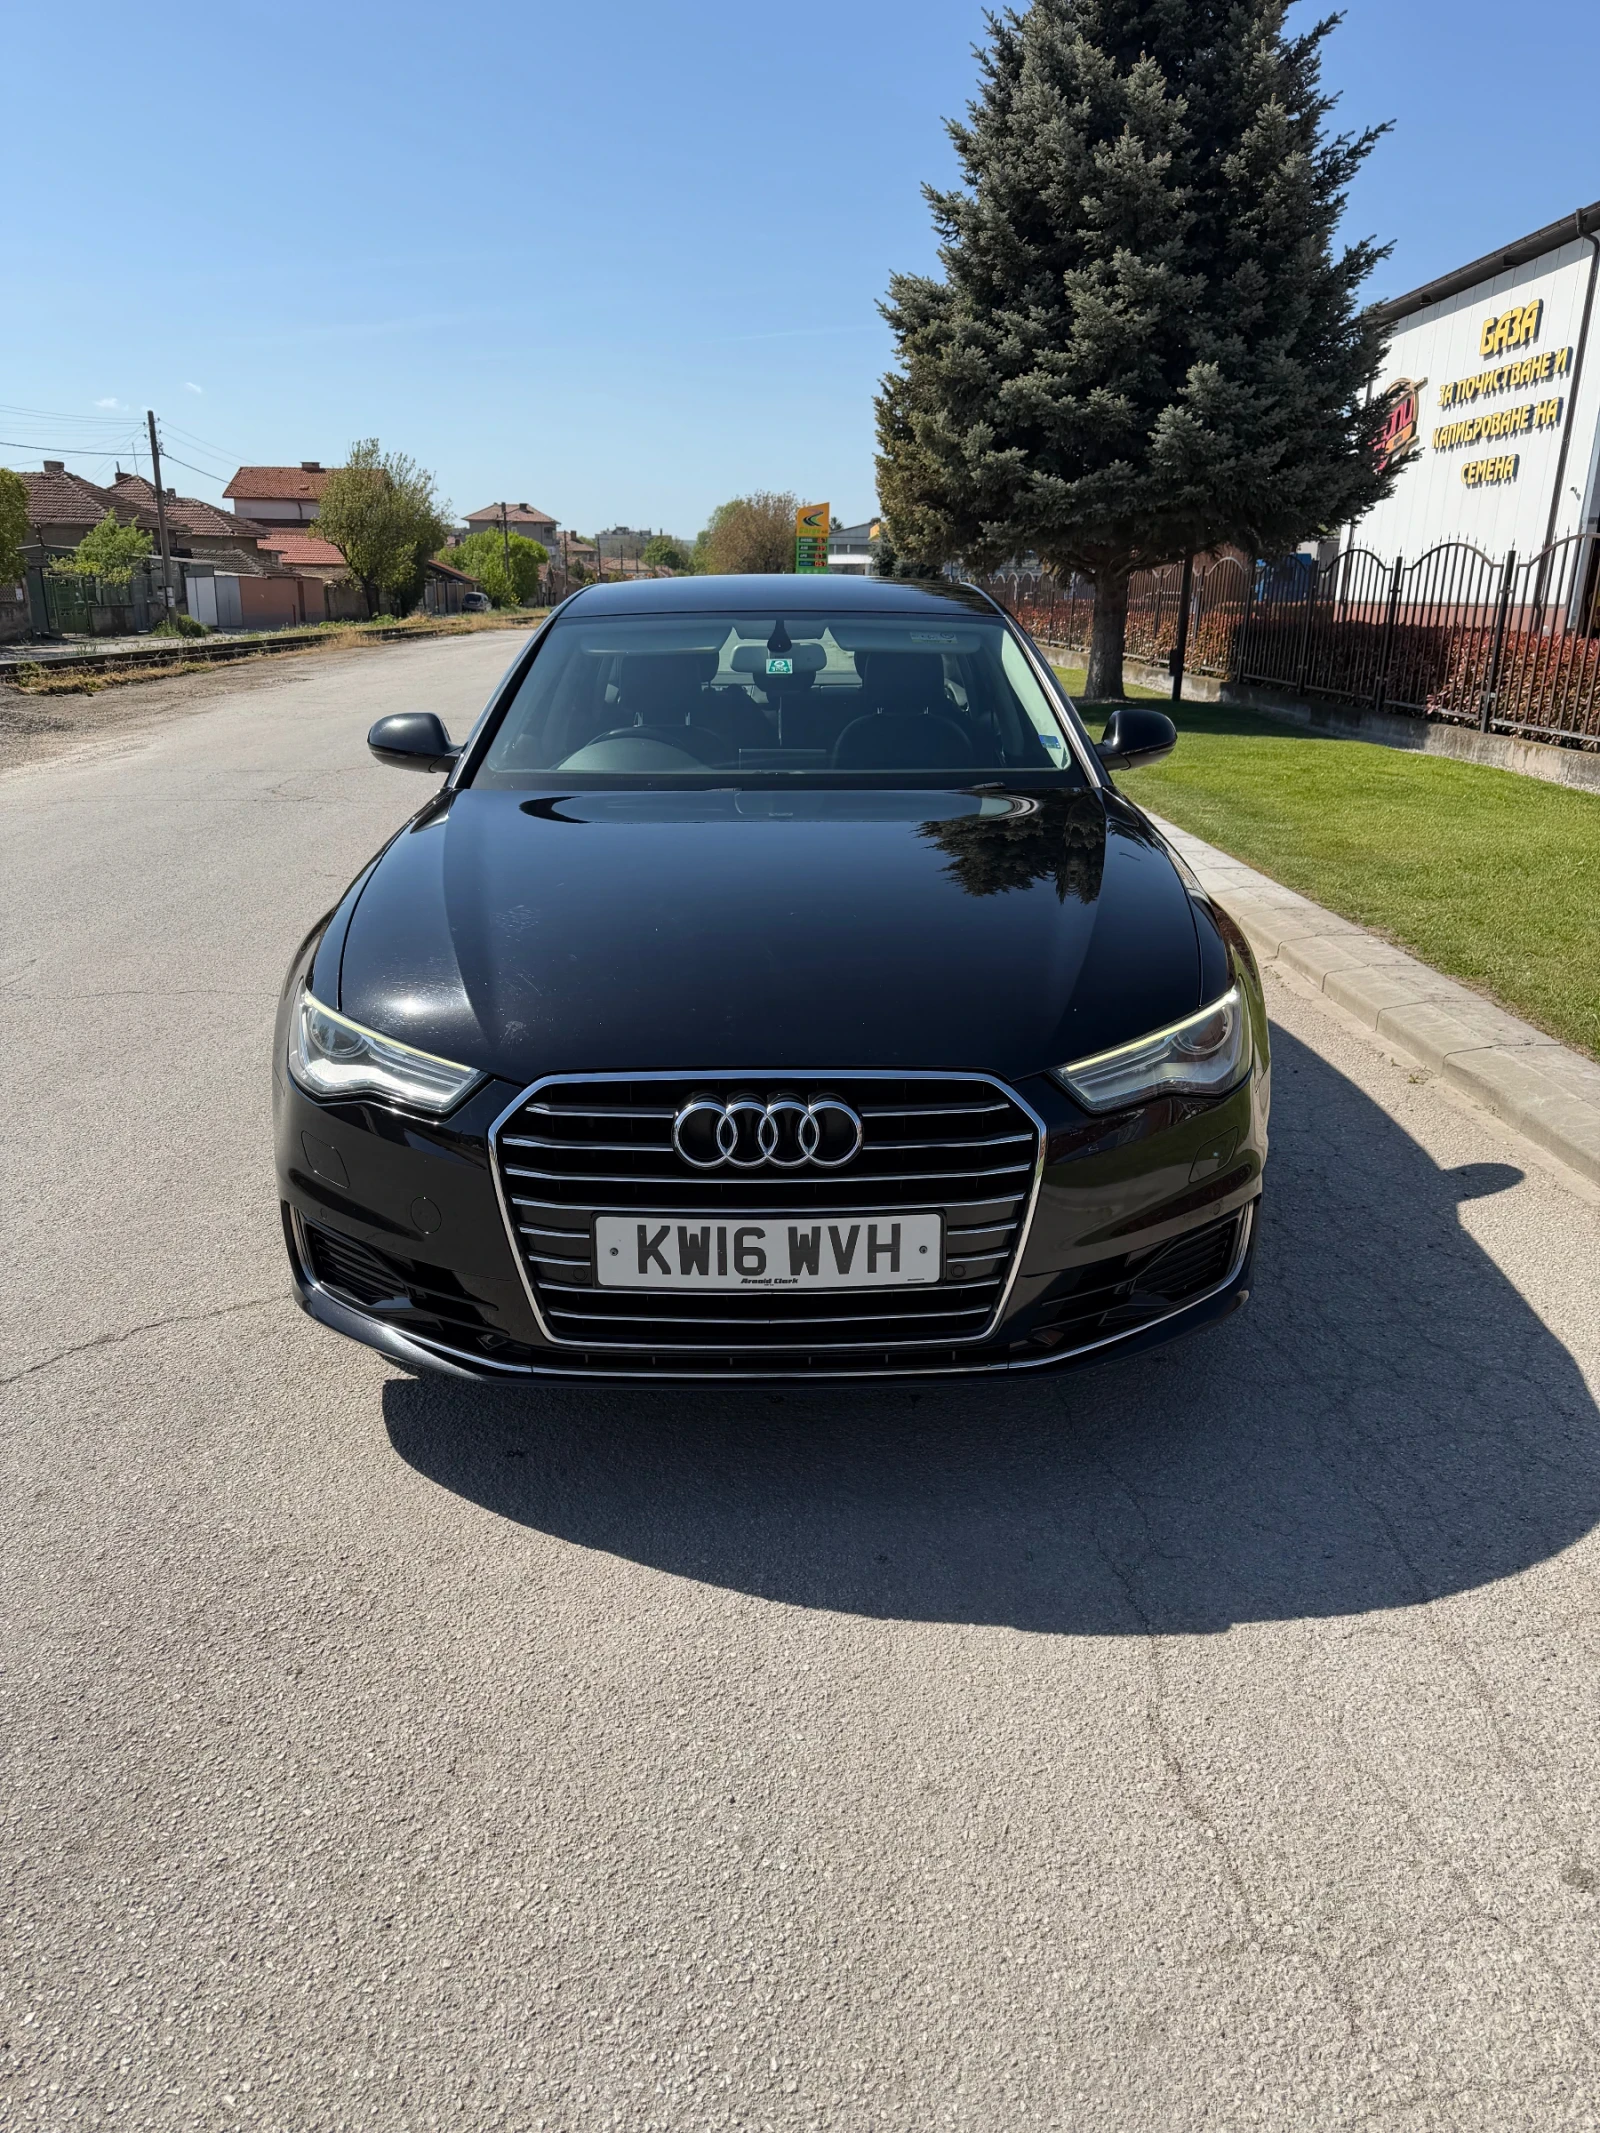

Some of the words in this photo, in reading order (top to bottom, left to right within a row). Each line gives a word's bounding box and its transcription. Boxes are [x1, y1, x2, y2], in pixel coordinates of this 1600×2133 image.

[1479, 299, 1540, 356] БАЗА
[1437, 382, 1455, 406] ЗА
[1455, 352, 1551, 403] ПОЧИСТВАНЕ
[1552, 346, 1569, 374] И
[1432, 404, 1530, 448] КАЛИБРОВАНЕ
[1533, 397, 1559, 427] НА
[1461, 454, 1515, 486] СЕМЕНА
[636, 1224, 767, 1276] KW16
[787, 1223, 901, 1276] WVH
